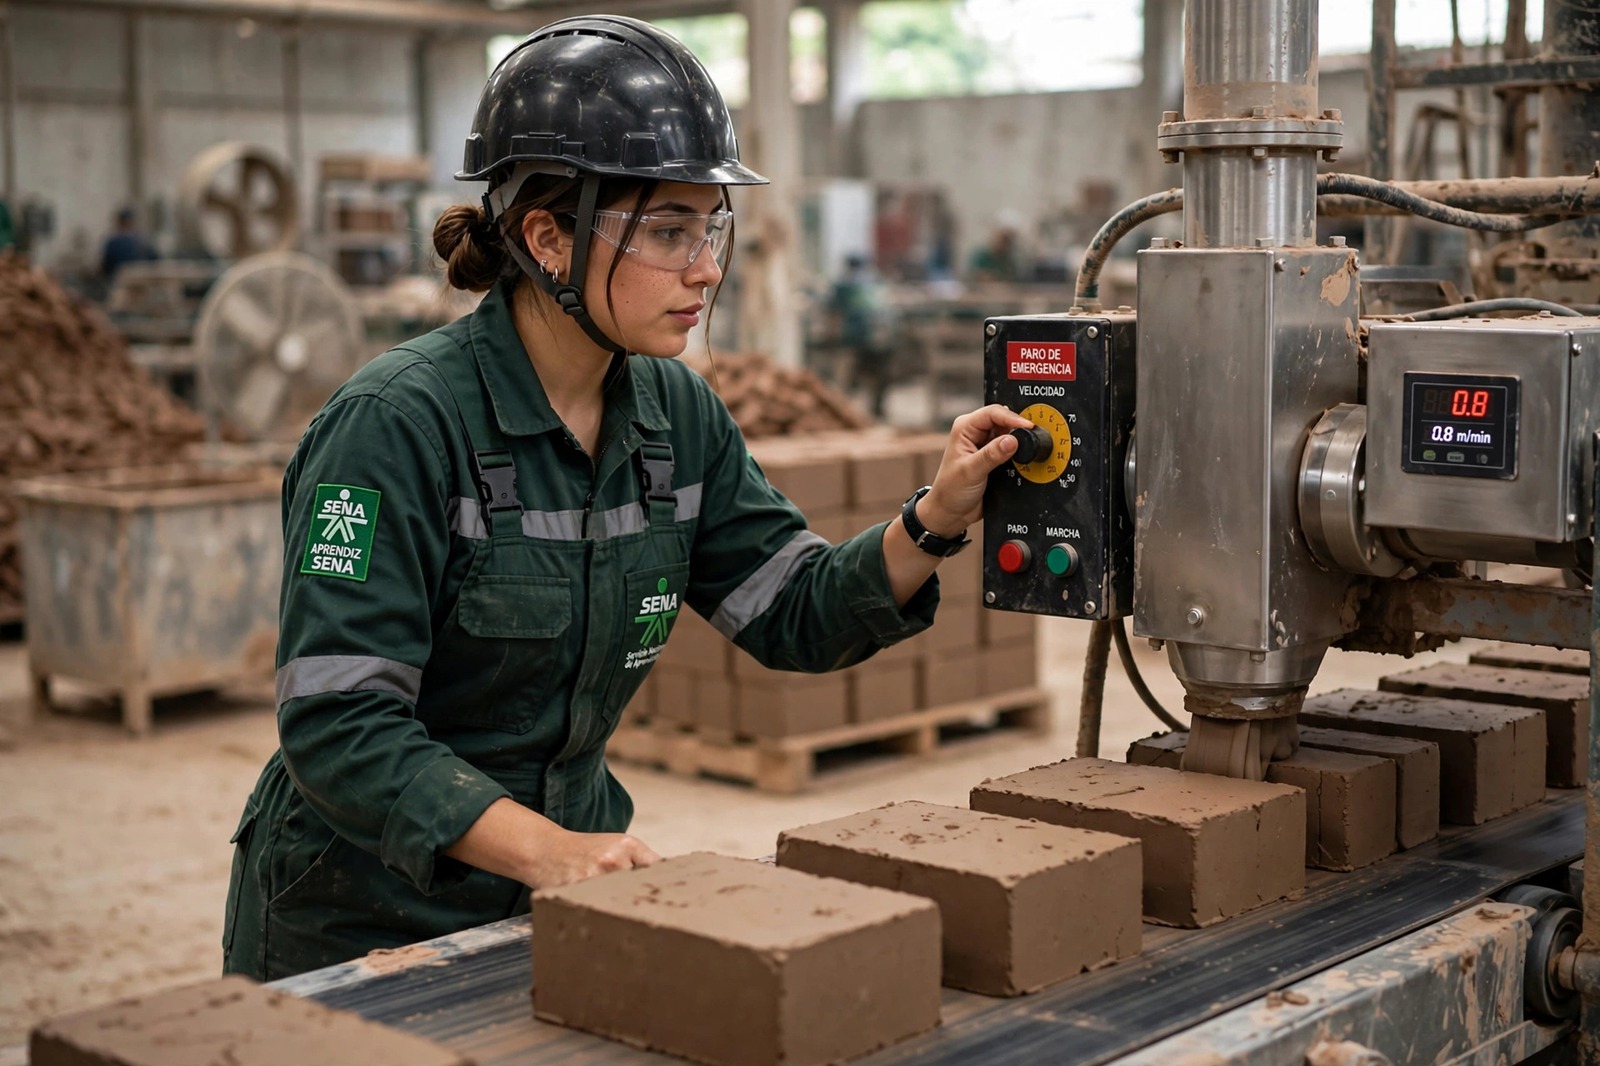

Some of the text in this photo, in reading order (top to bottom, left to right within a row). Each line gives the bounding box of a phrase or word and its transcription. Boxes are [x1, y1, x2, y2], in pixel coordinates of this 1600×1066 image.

[1020, 347, 1061, 360] PARO DE
[1010, 362, 1072, 375] EMERGENCIA
[1018, 385, 1065, 397] VELOCIDAD
[1451, 390, 1489, 417] 0.8
[1431, 425, 1491, 444] 0.8 m/min
[322, 500, 365, 518] SENA
[1007, 524, 1029, 535] PARO
[1046, 526, 1080, 539] MARCHA
[310, 543, 362, 560] APRENDIZ
[311, 555, 354, 575] SENA
[640, 593, 677, 614] SENA
